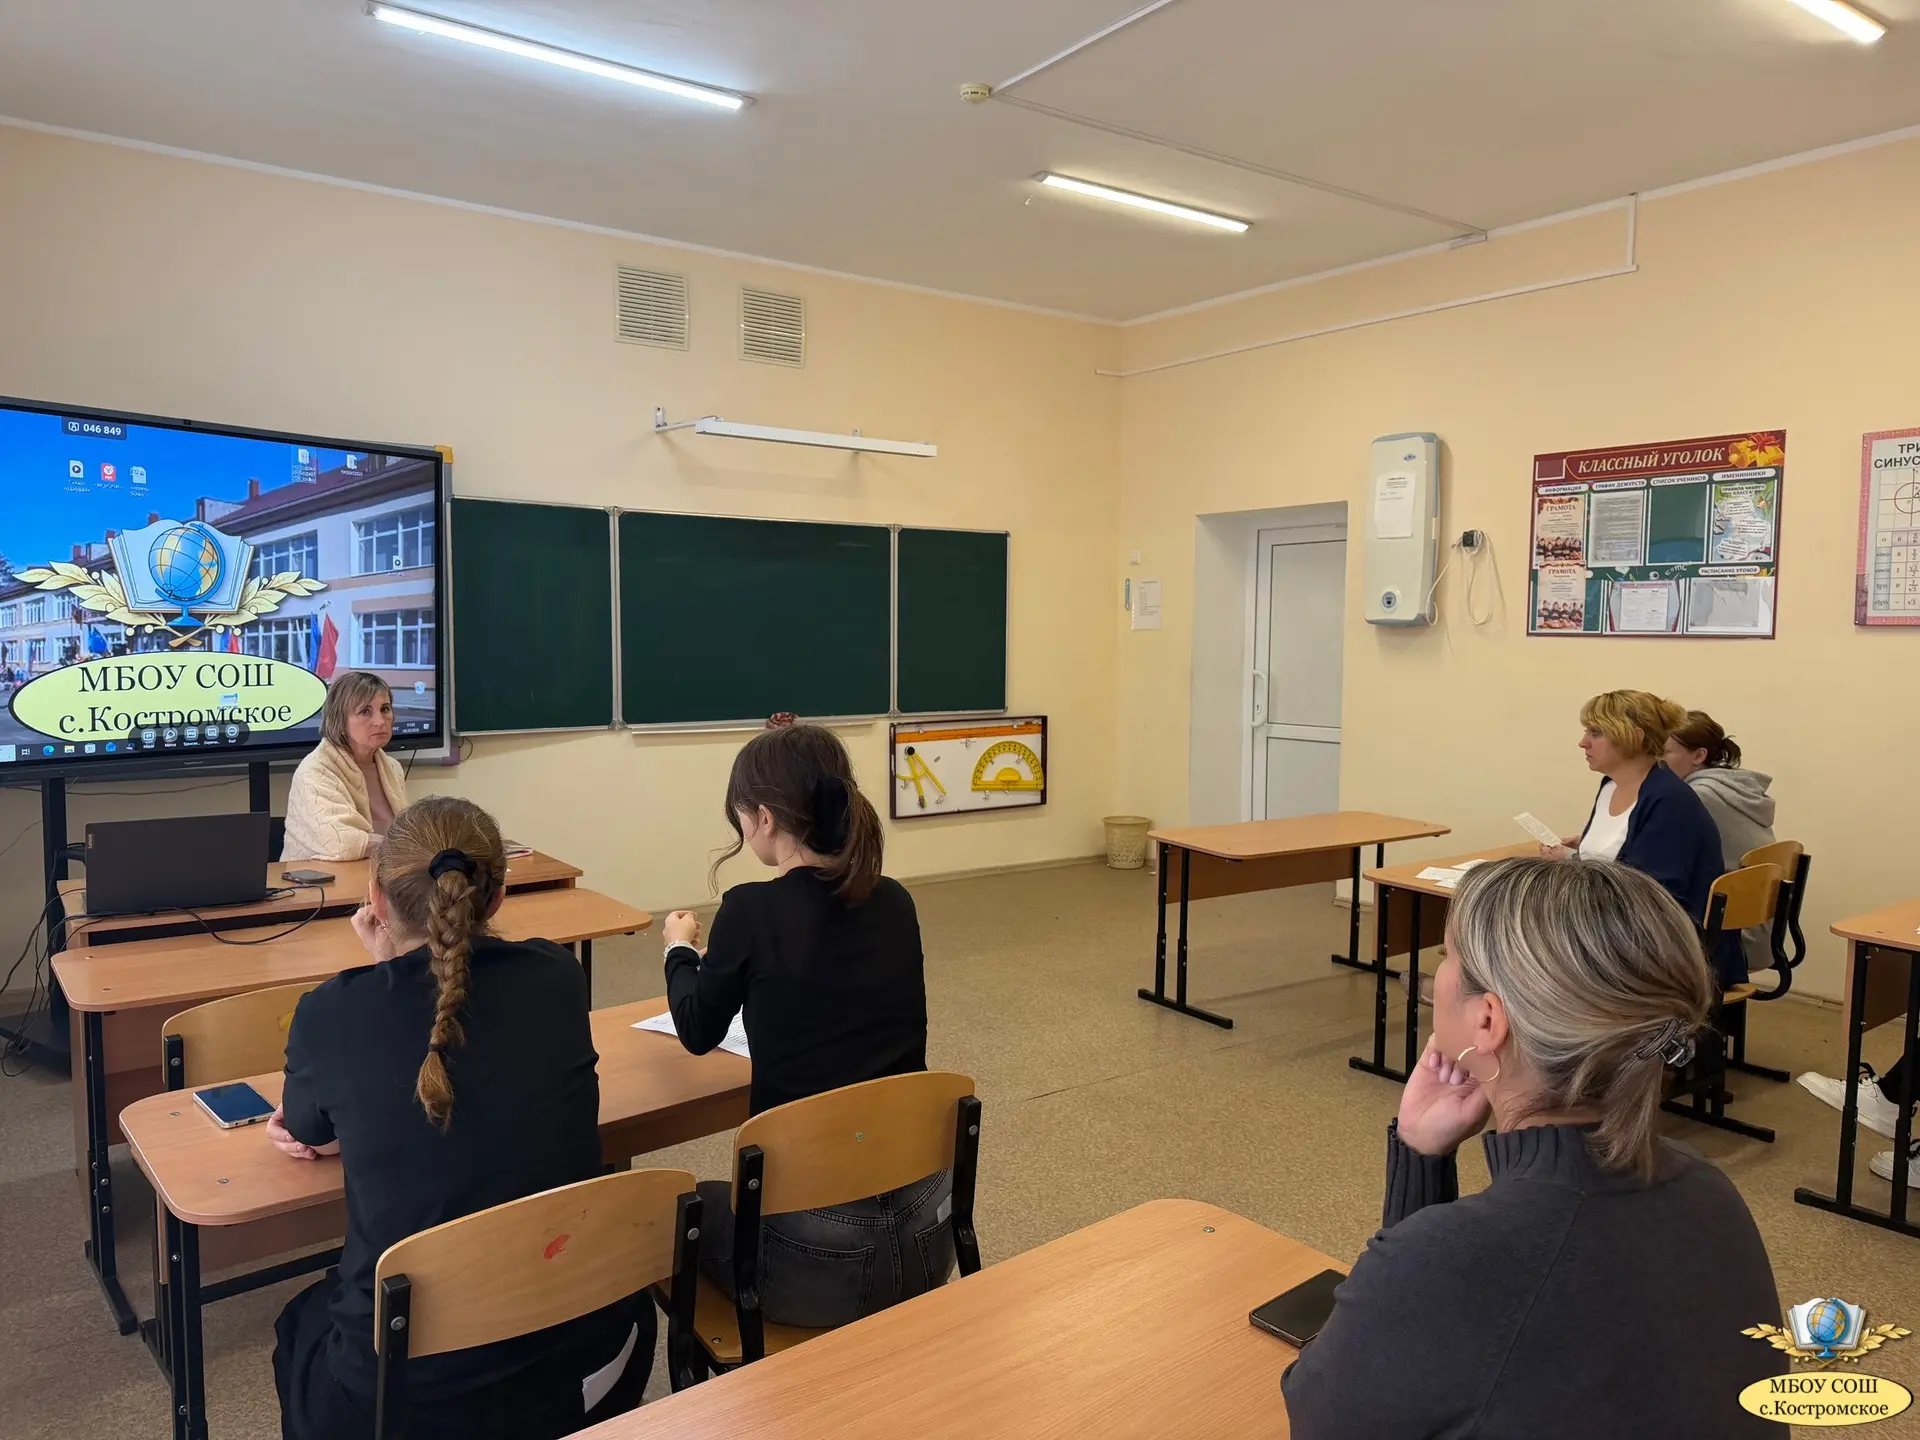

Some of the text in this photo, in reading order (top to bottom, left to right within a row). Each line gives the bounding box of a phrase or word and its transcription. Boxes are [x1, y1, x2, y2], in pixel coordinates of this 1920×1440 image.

[83, 423, 122, 436] 046 849
[1578, 447, 1726, 473] КЛАССНЫЙ УГОЛОК
[1676, 476, 1707, 484] УЧЕНИКОВ
[1721, 471, 1767, 479] ИМЕНИННИКИ
[1544, 485, 1582, 493] ИНФОРМАЦИЯ
[1546, 504, 1576, 512] ГРАМОТА
[78, 663, 274, 693] МБОУ СОШ
[59, 703, 292, 735] с.Костромское
